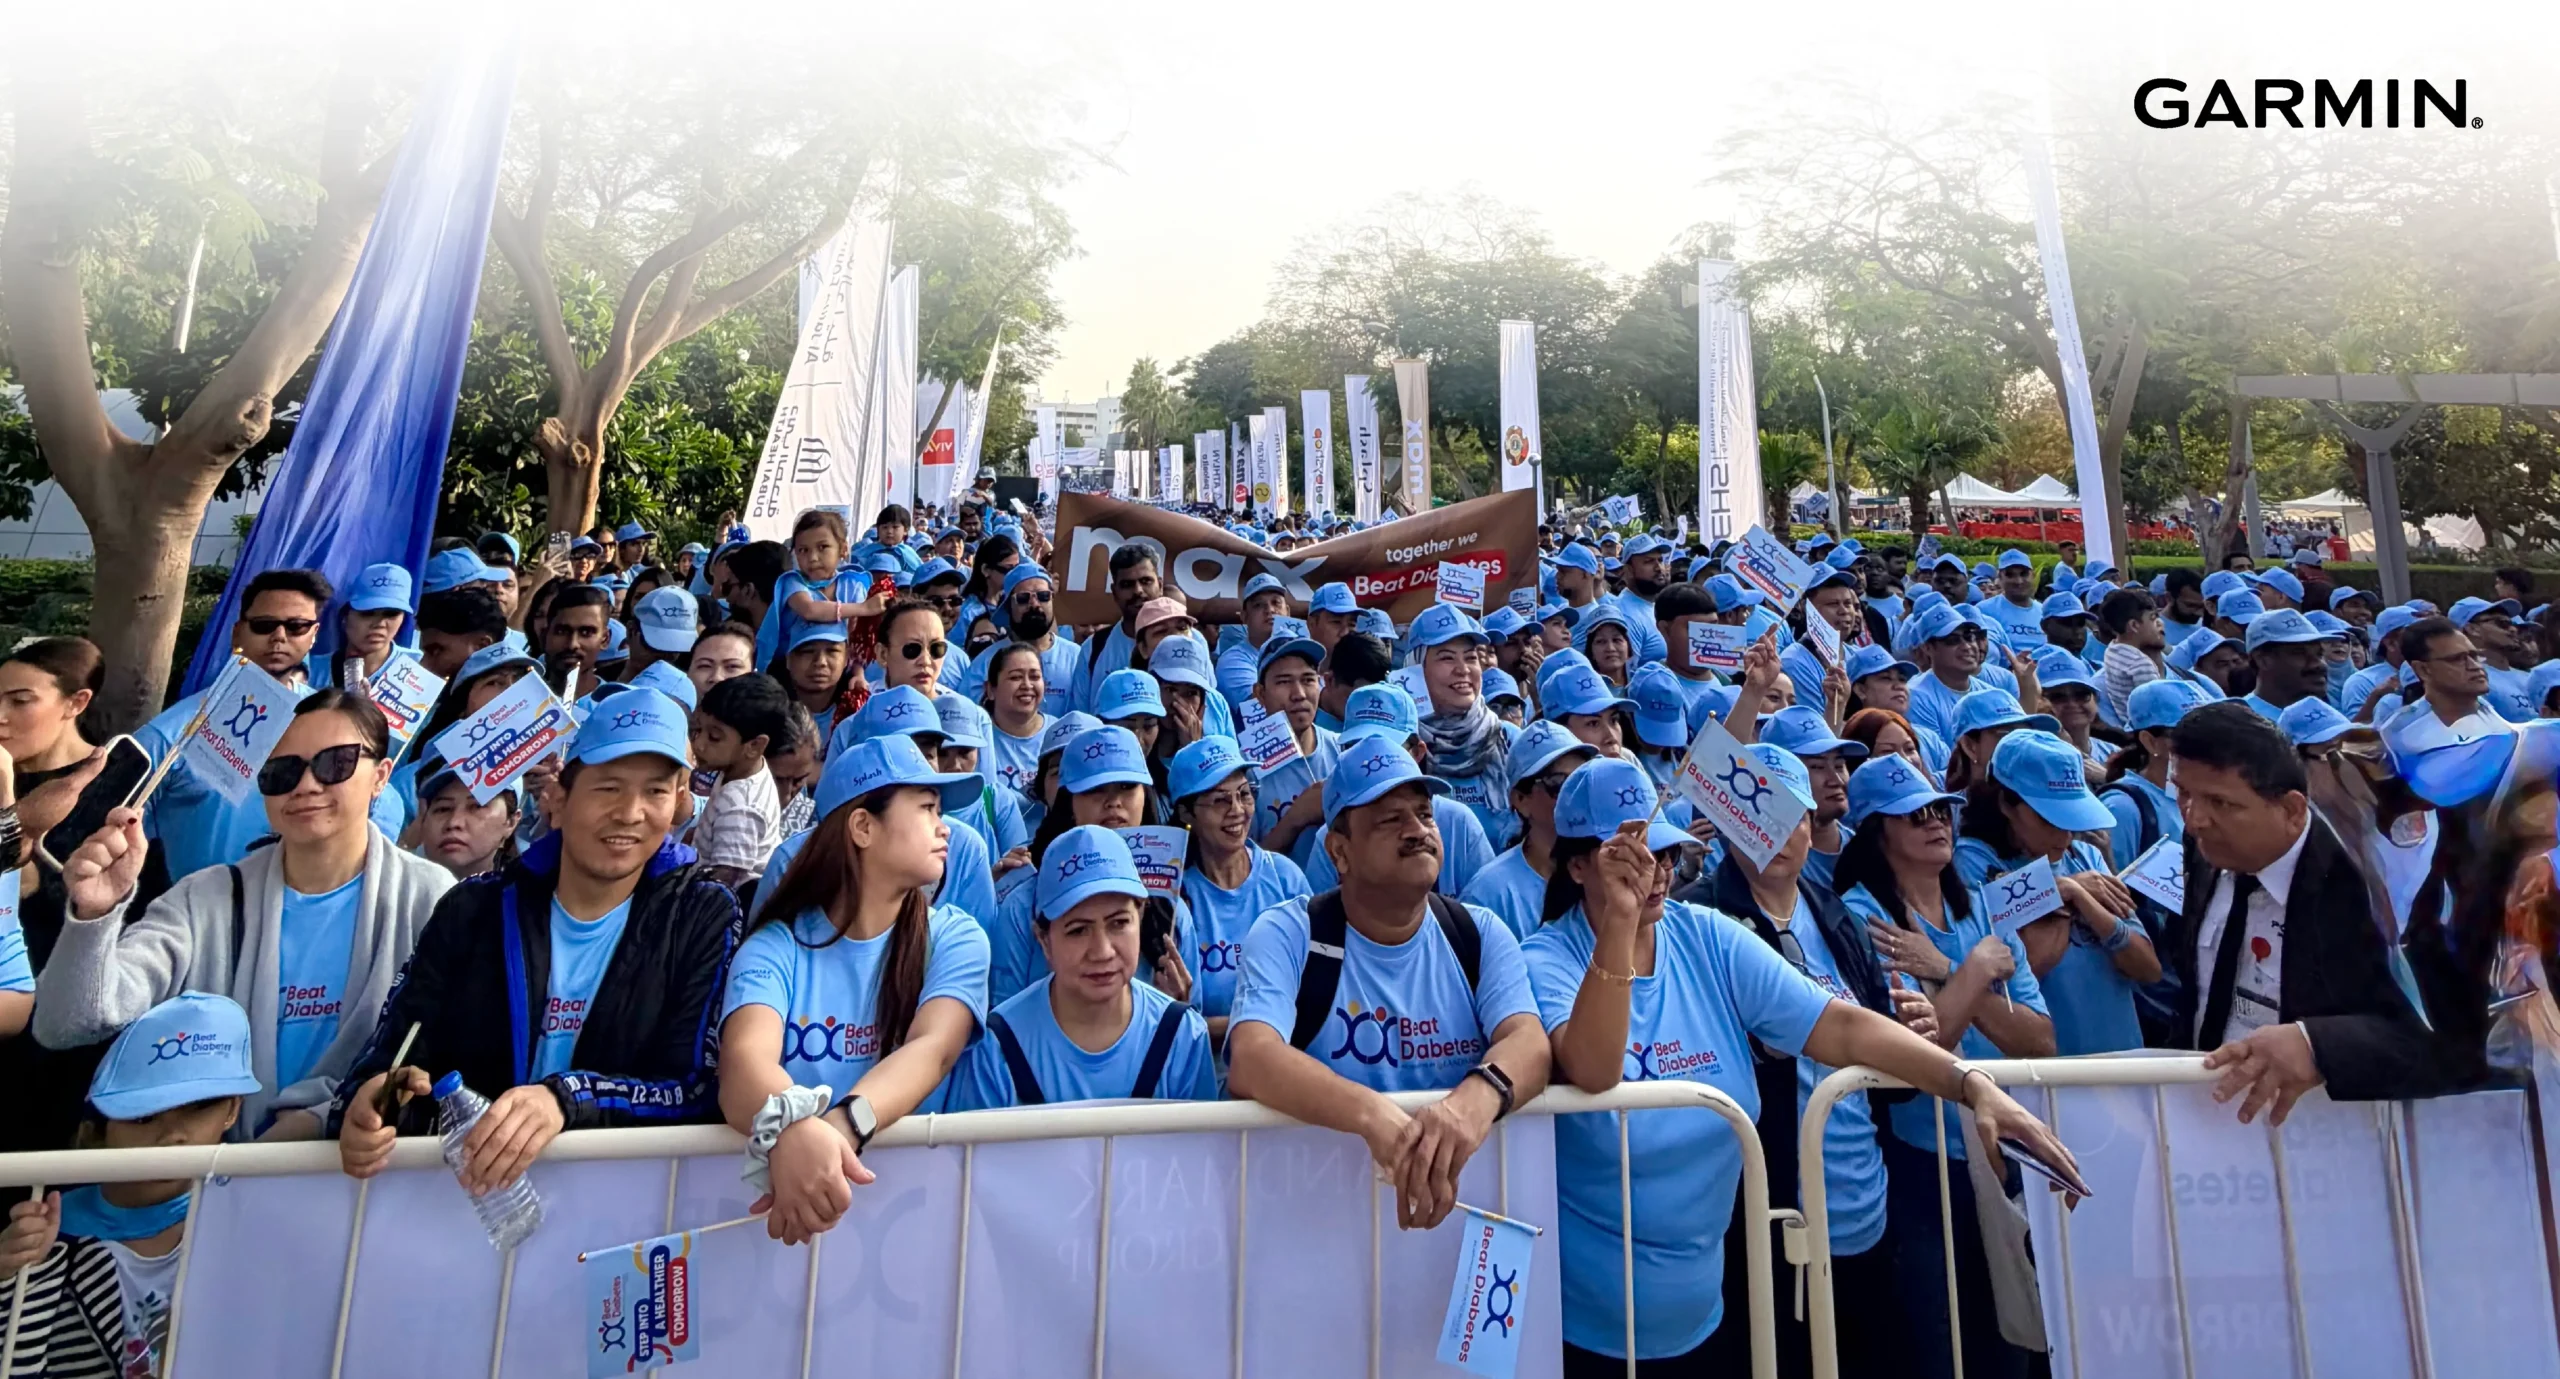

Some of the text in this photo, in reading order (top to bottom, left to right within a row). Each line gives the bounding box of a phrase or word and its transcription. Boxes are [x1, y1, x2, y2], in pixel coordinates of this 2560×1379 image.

[1385, 532, 1478, 564] together we
[1355, 575, 1406, 596] Beat
[466, 732, 512, 769] STEP INTO
[491, 731, 551, 781] TOMORROW
[493, 713, 555, 765] A HEALTHIER
[215, 737, 253, 779] Diabetes
[853, 768, 883, 786] Splash
[1688, 763, 1717, 794] Beat
[1717, 790, 1775, 849] Diabetes
[284, 1000, 342, 1018] Diabet
[287, 985, 326, 1000] Beat
[550, 997, 586, 1013] Beat
[547, 1016, 581, 1031] Diab
[1400, 1017, 1440, 1037] Beat
[1653, 1039, 1683, 1057] Beat
[1658, 1050, 1718, 1075] Diabetes
[1477, 1225, 1494, 1271] Beat
[611, 1276, 622, 1319] Diabetes
[654, 1254, 665, 1320] HEALTHIER
[672, 1266, 684, 1339] TOMORROW
[602, 1298, 611, 1320] Beat
[1458, 1274, 1486, 1363] Diabetes
[638, 1304, 650, 1357] STEP INTO
